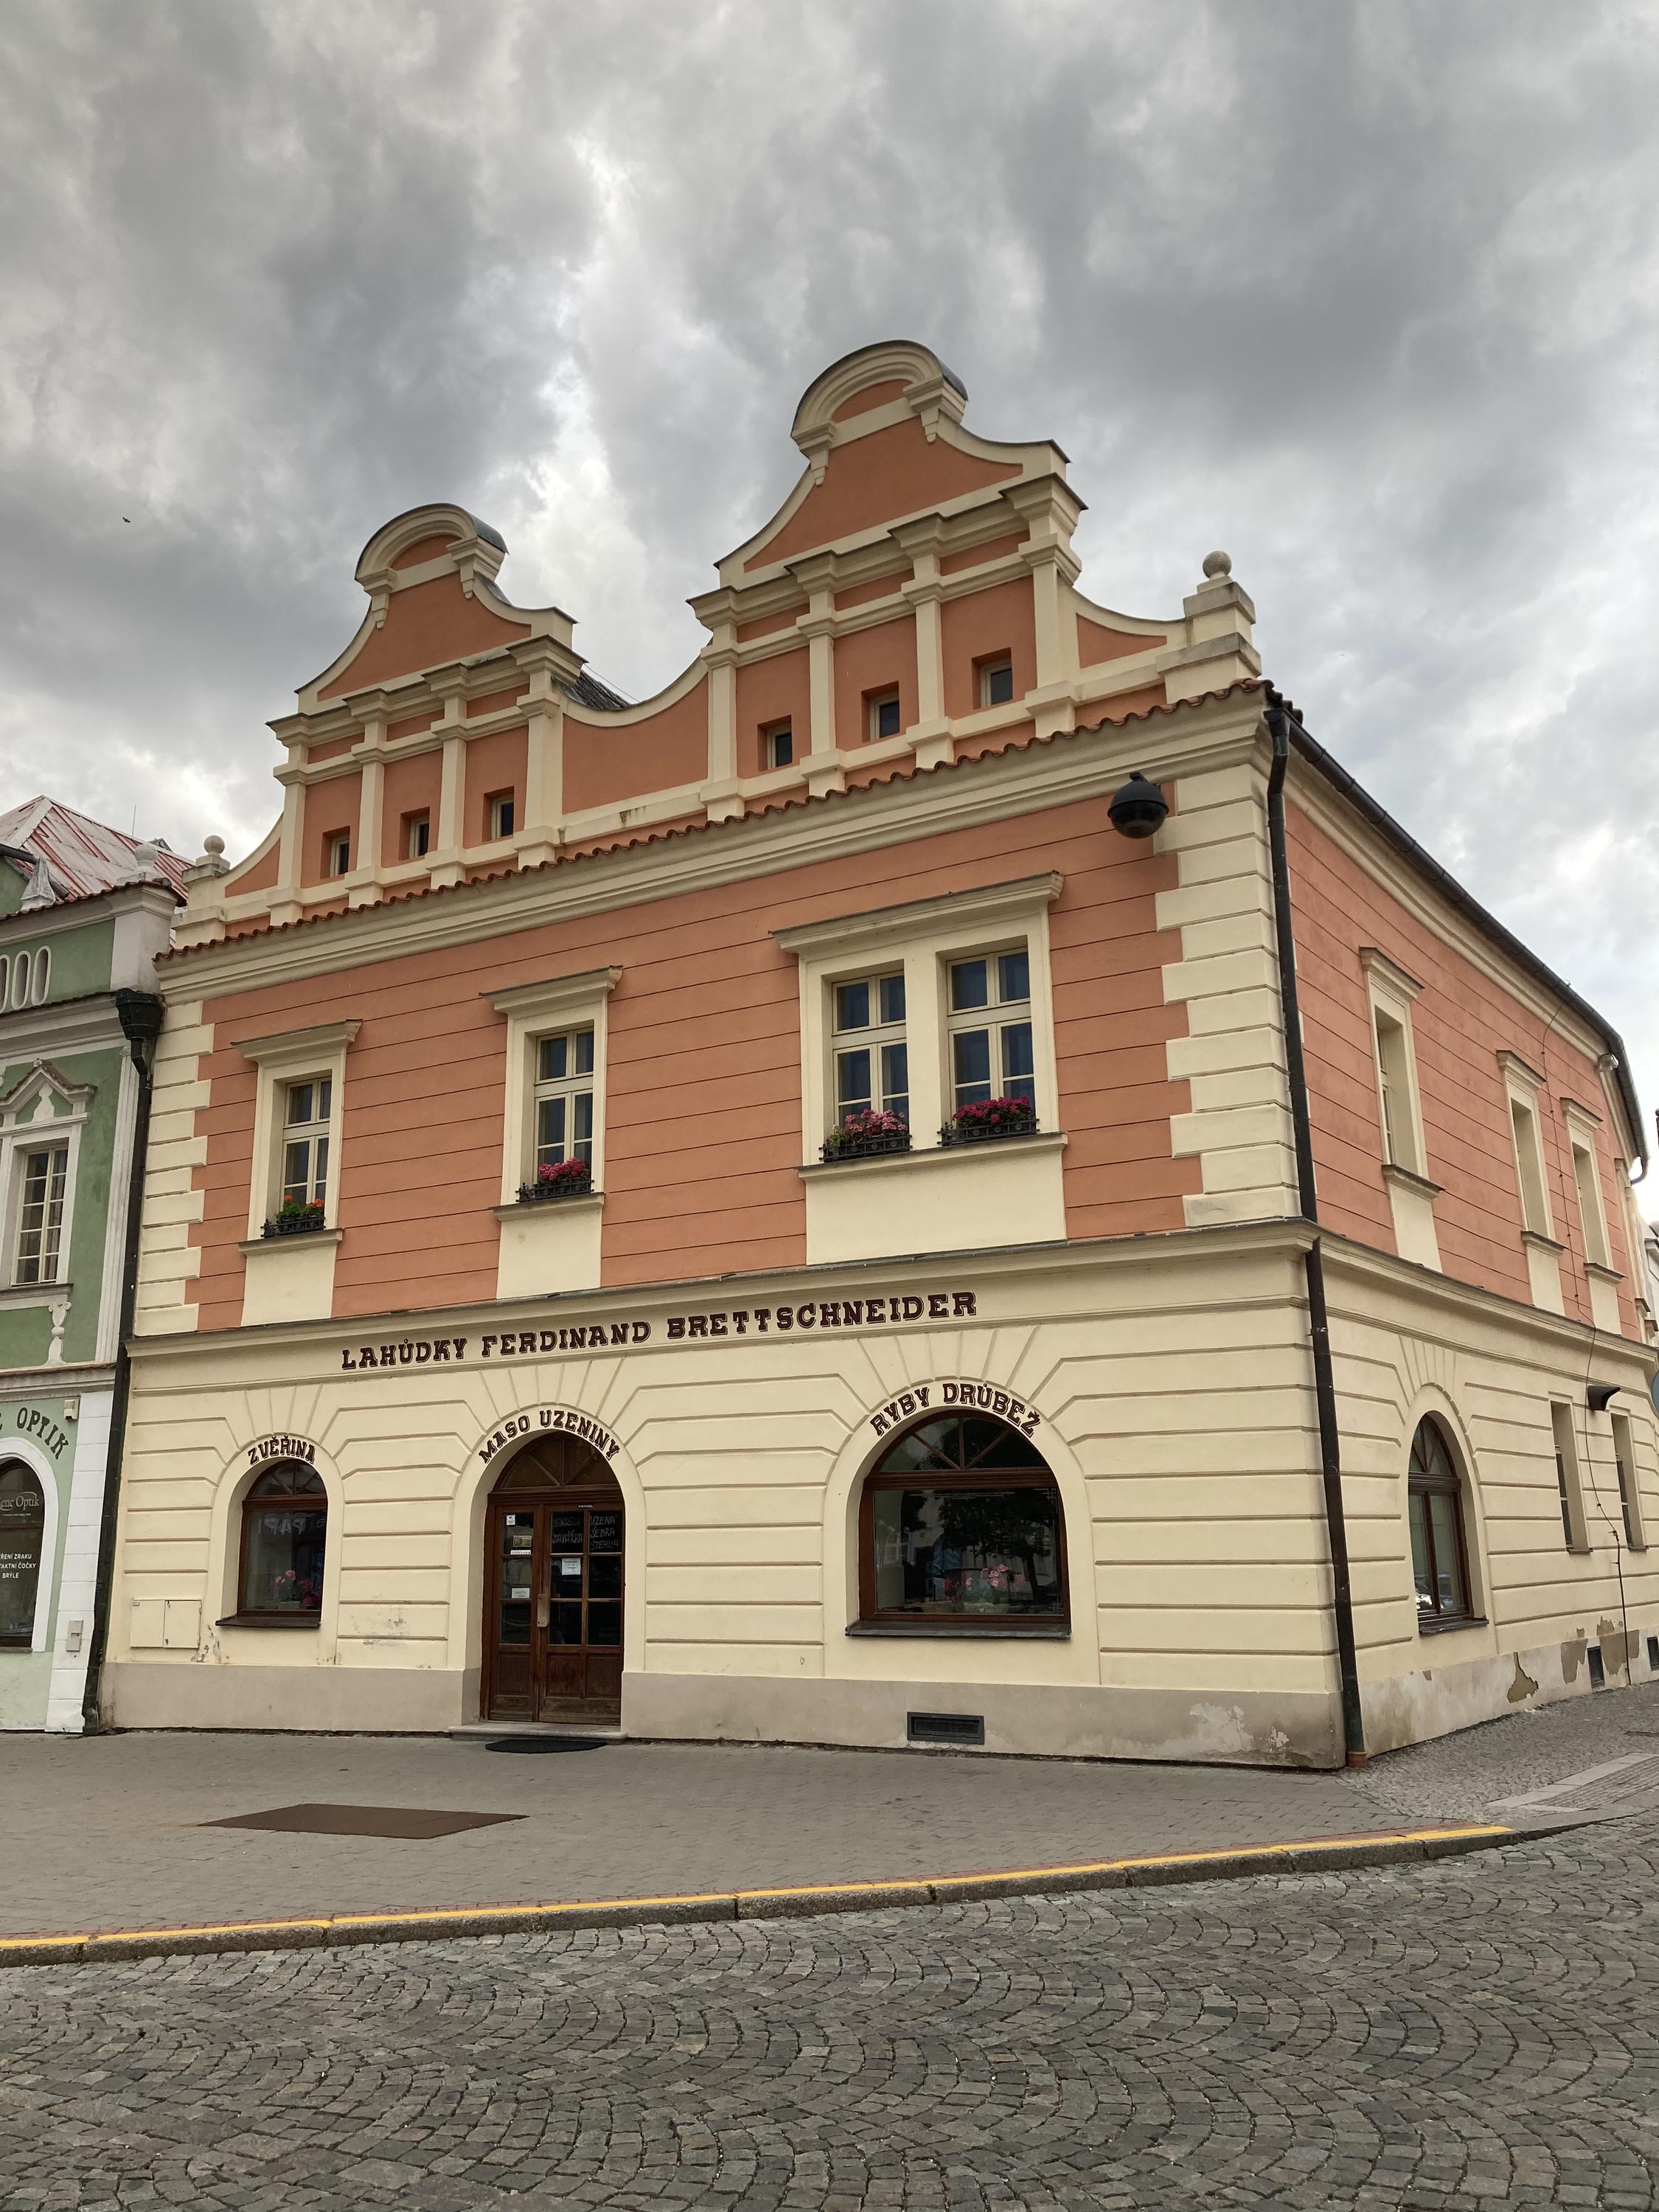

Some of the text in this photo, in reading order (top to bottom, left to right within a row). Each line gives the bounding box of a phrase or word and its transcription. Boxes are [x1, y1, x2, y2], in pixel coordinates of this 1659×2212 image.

[342, 1290, 978, 1370] LAHŮDKY FERDINAND BRETTSCHNEIDER
[870, 1382, 1041, 1438] RYBY DRŮBEŽ
[17, 1407, 69, 1459] OPTIK
[248, 1435, 316, 1466] ZVĚŘINA
[479, 1410, 621, 1464] MASO UZENINY
[15, 1493, 39, 1511] Optik
[2, 1571, 19, 1579] BRÝLE
[18, 1561, 37, 1569] ČOČKY
